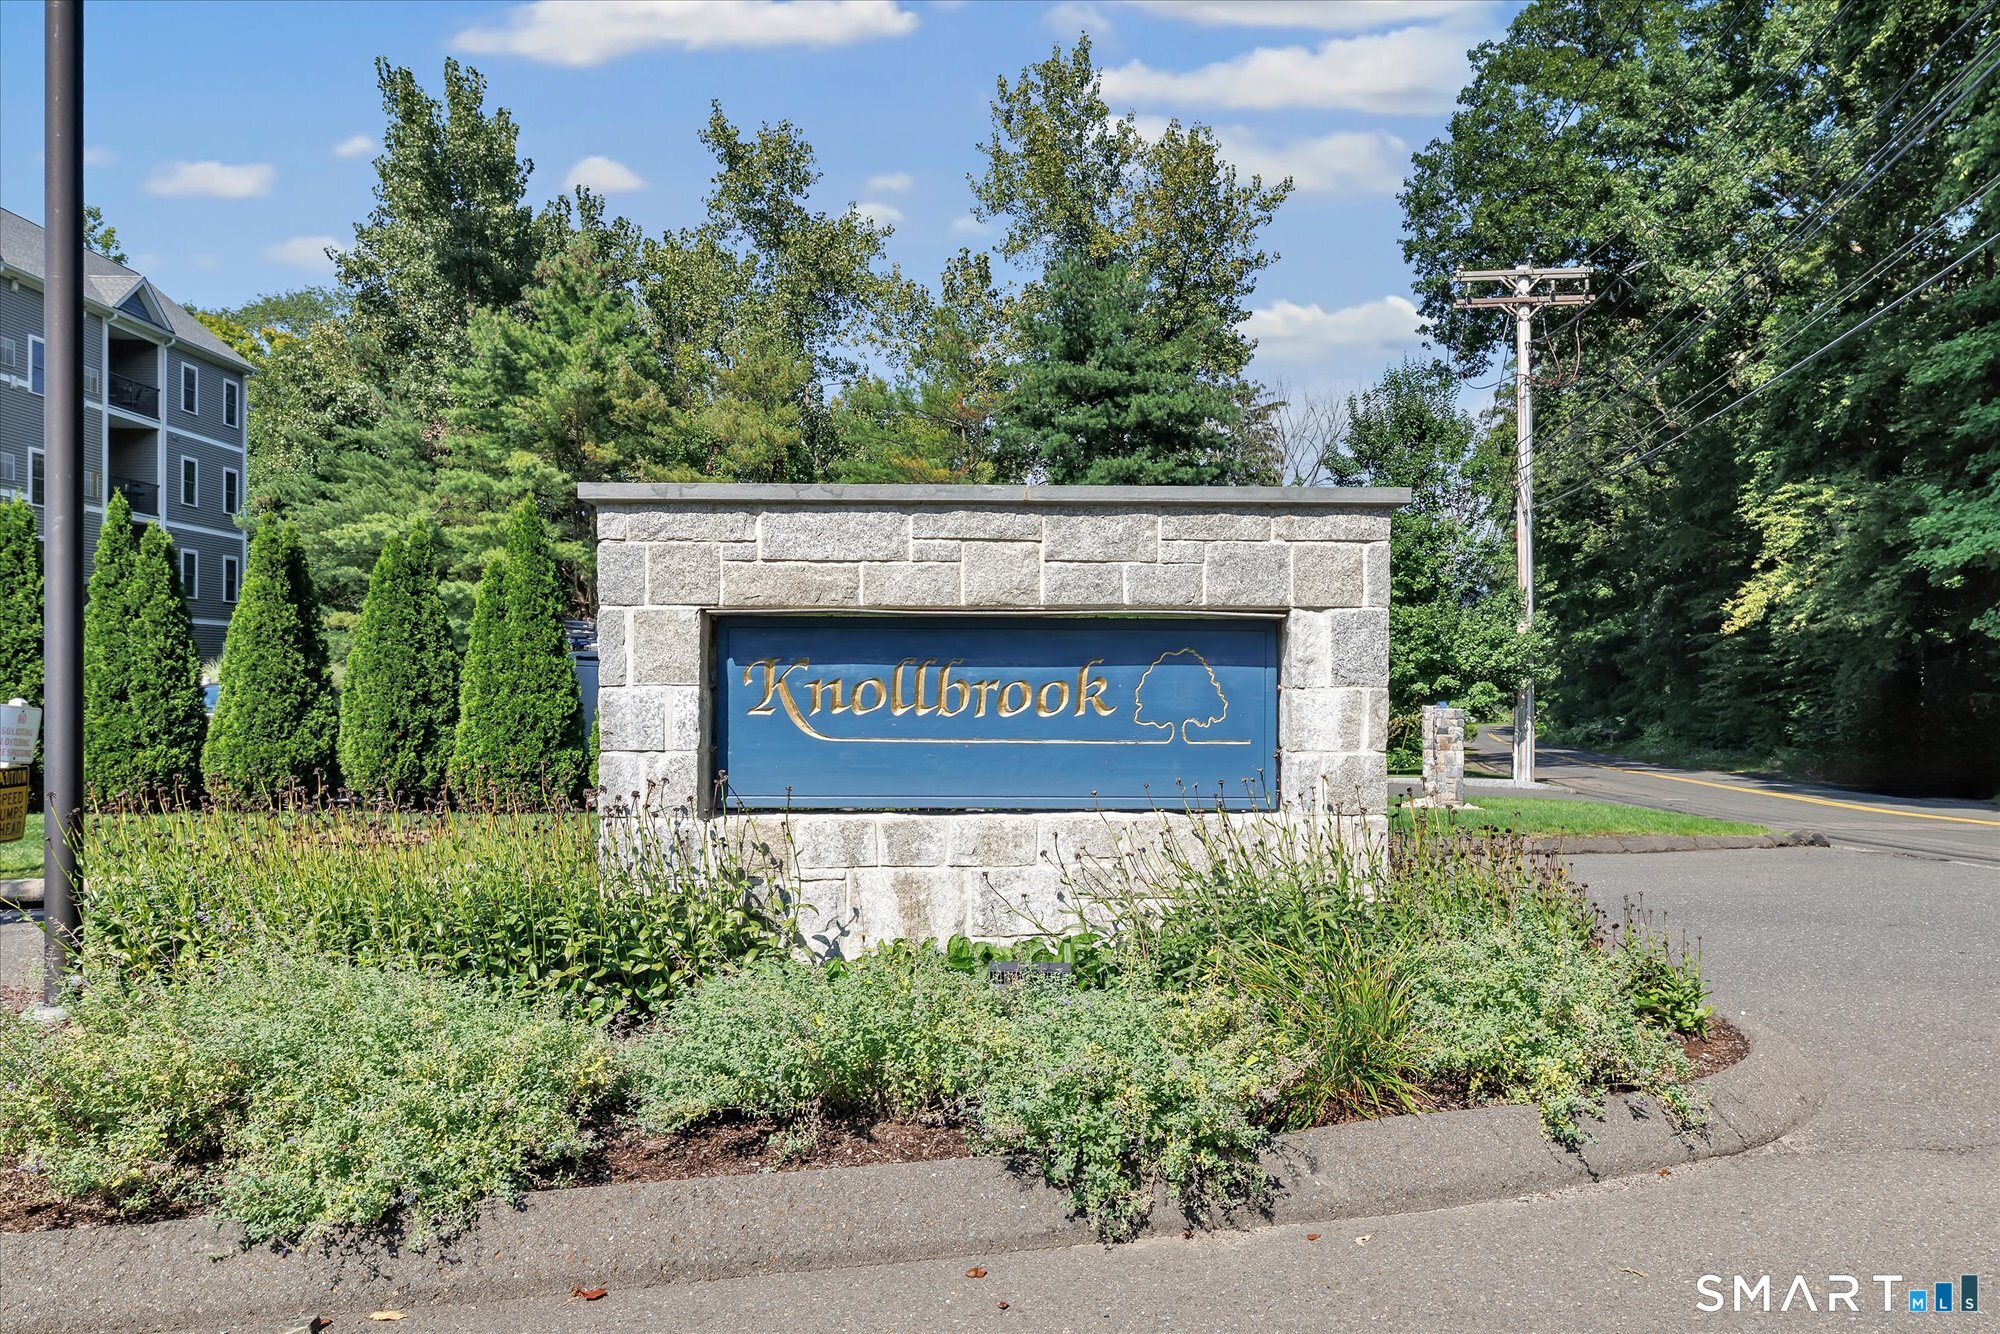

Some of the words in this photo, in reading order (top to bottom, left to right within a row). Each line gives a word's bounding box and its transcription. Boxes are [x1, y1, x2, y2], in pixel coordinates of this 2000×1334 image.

[743, 656, 1118, 728] Knollbrook
[17, 713, 27, 724] NO
[0, 770, 27, 785] AUTION
[0, 791, 23, 806] PEED
[0, 806, 23, 821] UMPS
[0, 821, 22, 836] HEAD
